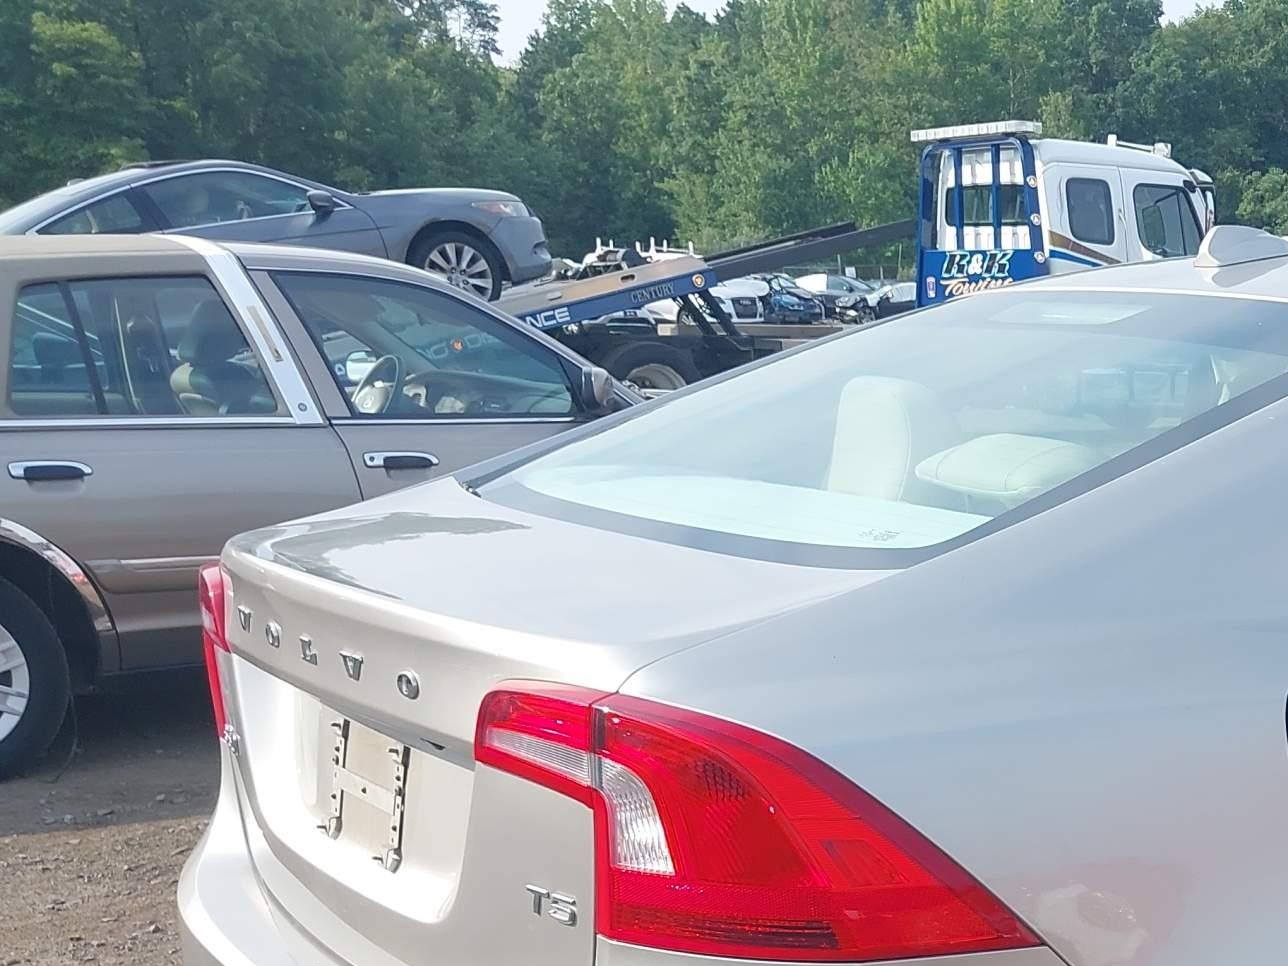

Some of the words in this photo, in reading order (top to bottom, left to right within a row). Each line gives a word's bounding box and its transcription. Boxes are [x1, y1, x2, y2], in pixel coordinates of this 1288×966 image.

[631, 283, 676, 304] CENTURY
[237, 604, 421, 700] VOLVO
[525, 884, 578, 928] T5
